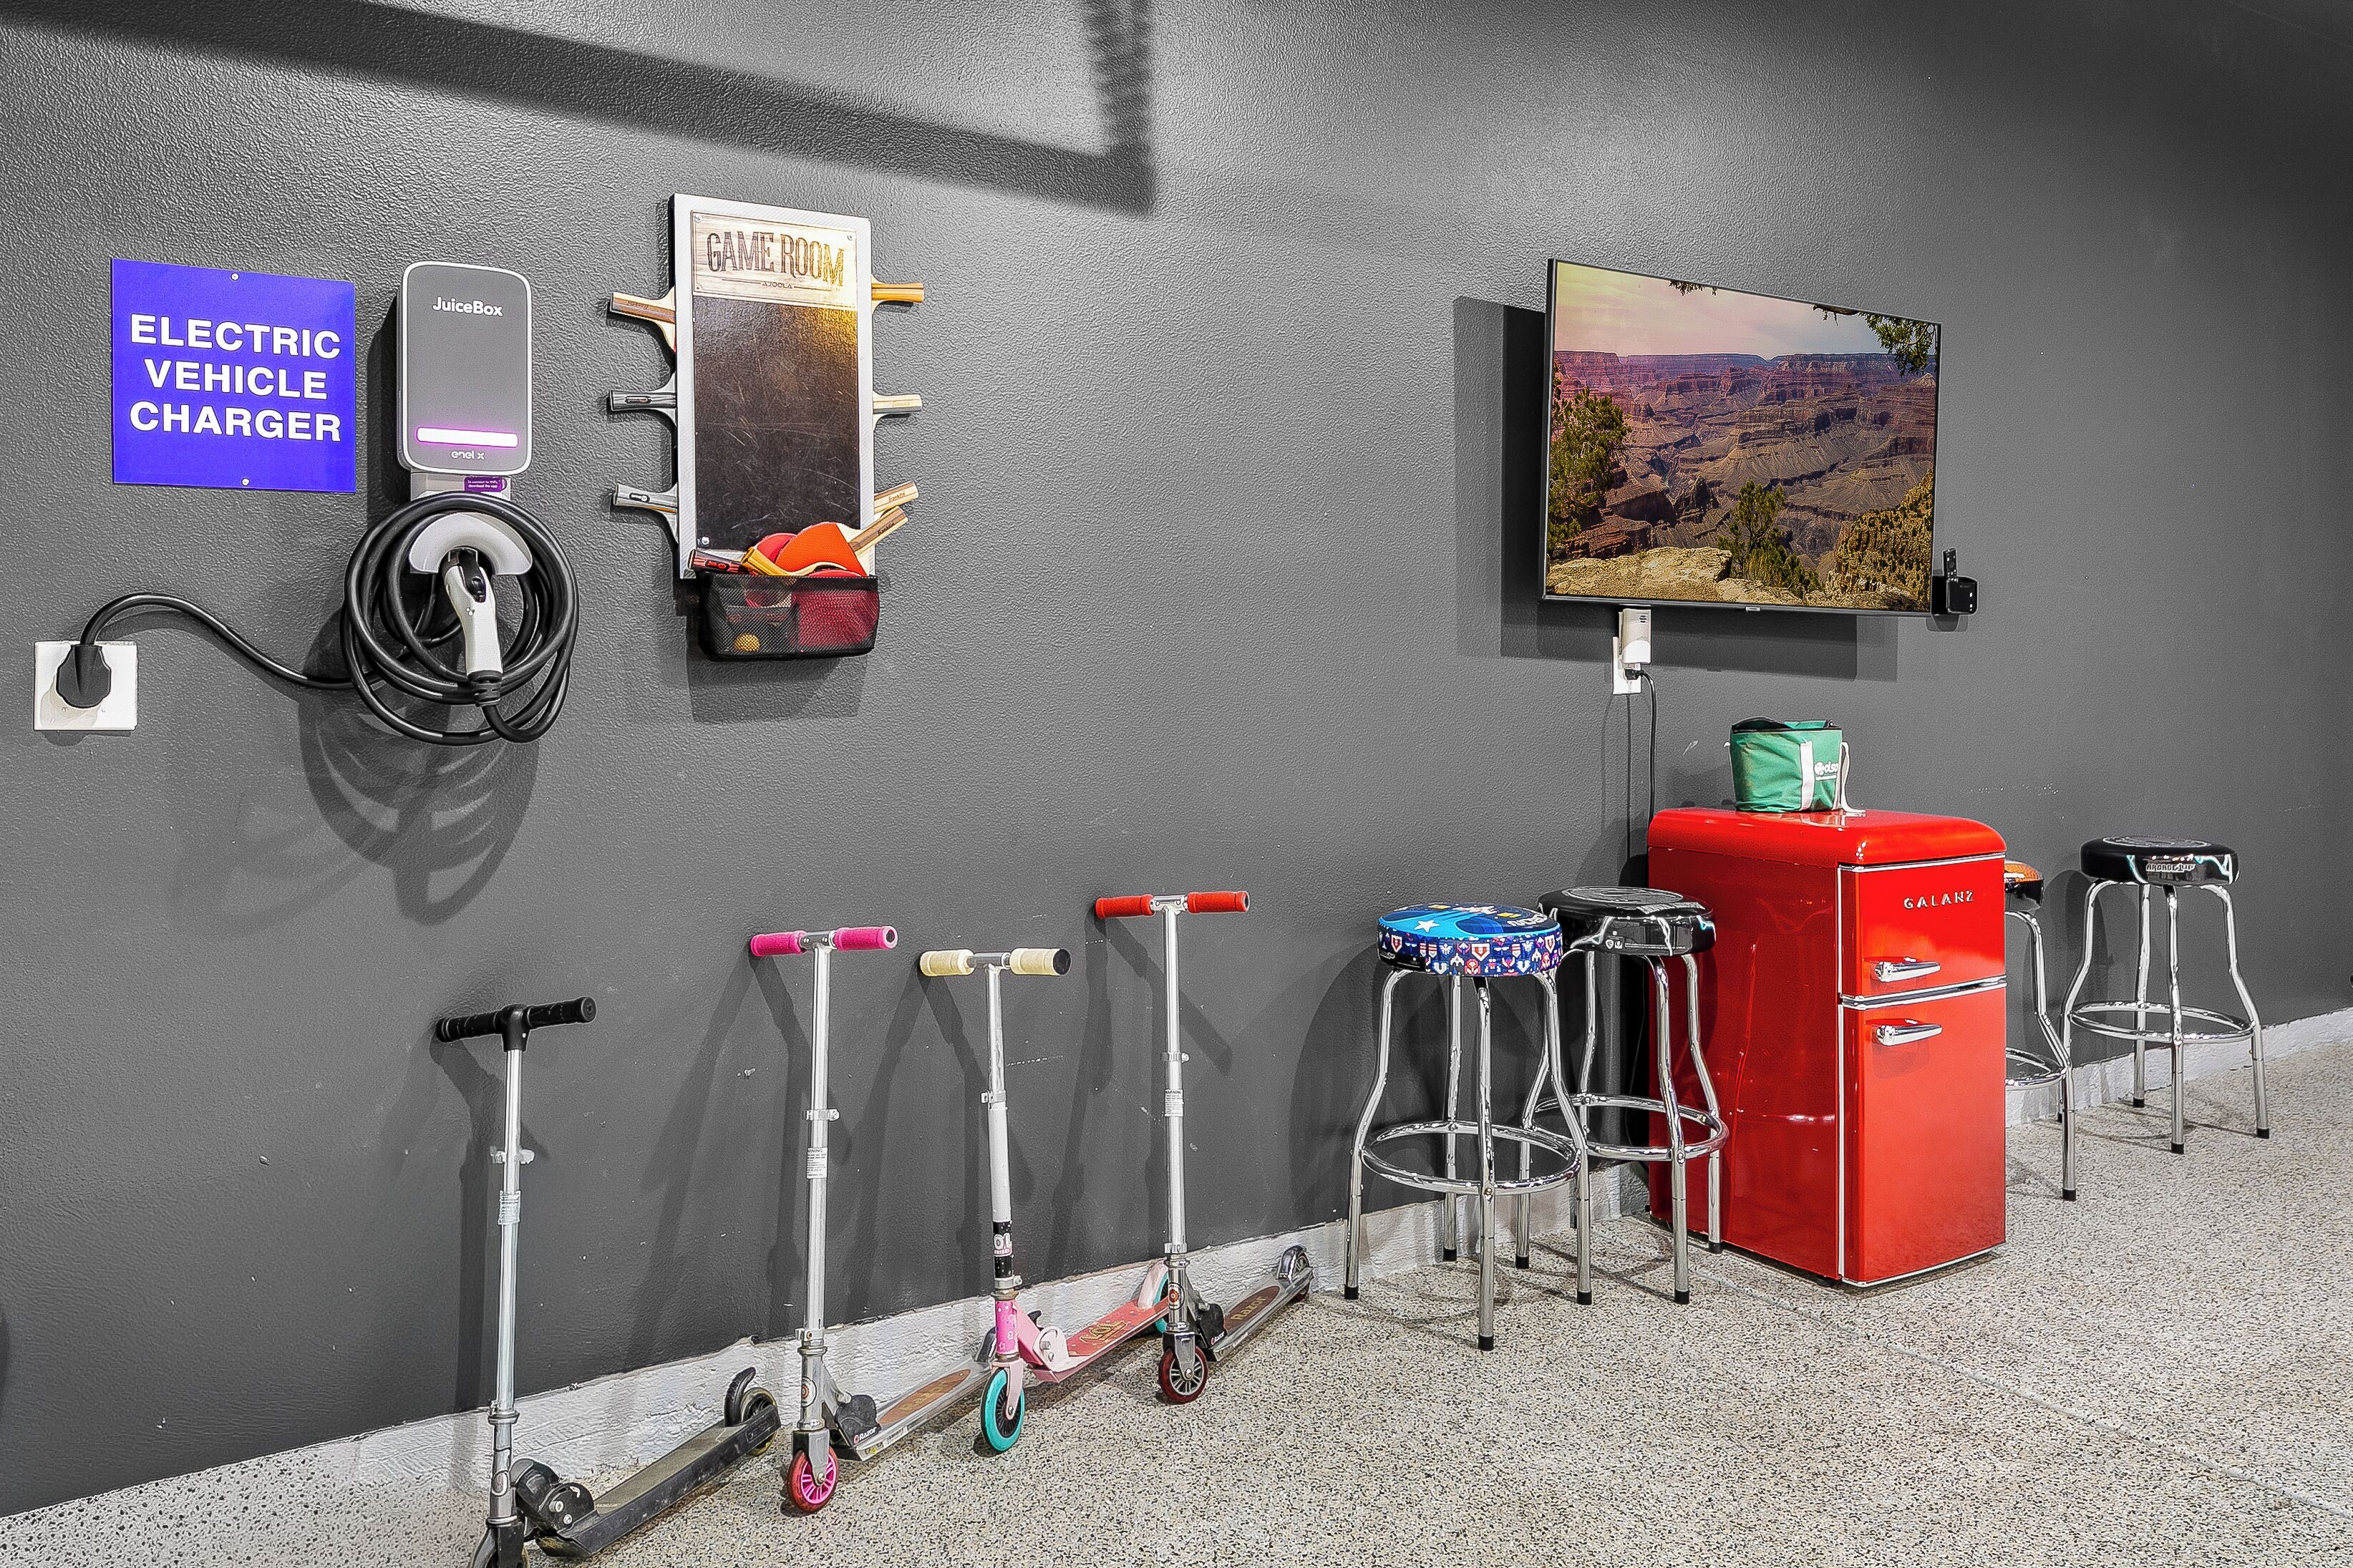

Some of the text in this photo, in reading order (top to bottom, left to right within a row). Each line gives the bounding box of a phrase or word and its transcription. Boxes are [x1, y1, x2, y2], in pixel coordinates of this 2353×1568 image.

[707, 230, 845, 287] GAME ROOM
[432, 296, 503, 316] JuiceBox
[130, 313, 341, 359] ELECTRIC
[144, 358, 327, 400] VEHICLE
[129, 401, 341, 442] CHARGER
[450, 449, 485, 460] enel x
[1903, 890, 1974, 910] GALANZ
[1231, 1296, 1266, 1320] Razor
[859, 1426, 877, 1441] Razor
